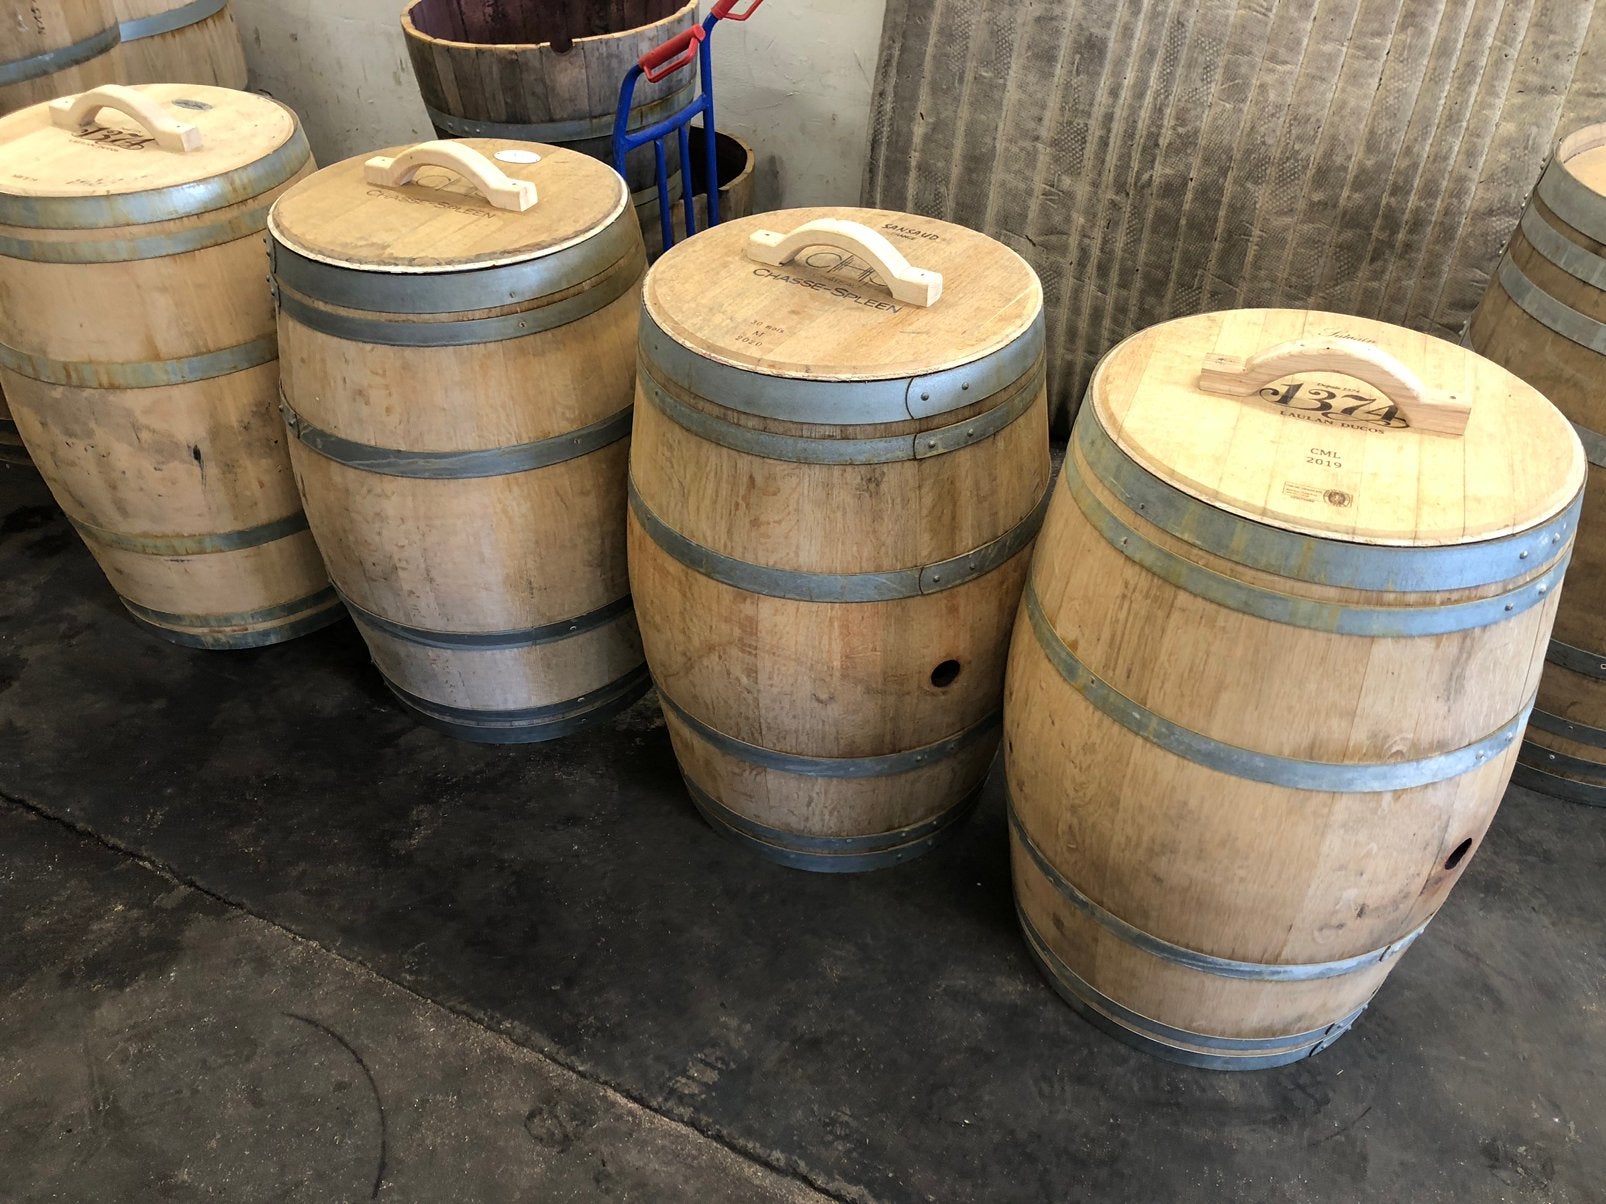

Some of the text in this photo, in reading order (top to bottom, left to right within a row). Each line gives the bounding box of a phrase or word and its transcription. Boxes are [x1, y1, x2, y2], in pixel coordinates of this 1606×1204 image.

[881, 223, 939, 240] SANSAUD
[752, 268, 903, 314] CHASSE-SPLEEN
[735, 335, 763, 347] 2020
[1259, 382, 1410, 429] 1374
[1280, 410, 1386, 435] LAULAN DUCOS
[1309, 447, 1342, 460] CML
[1306, 456, 1343, 469] 2019
